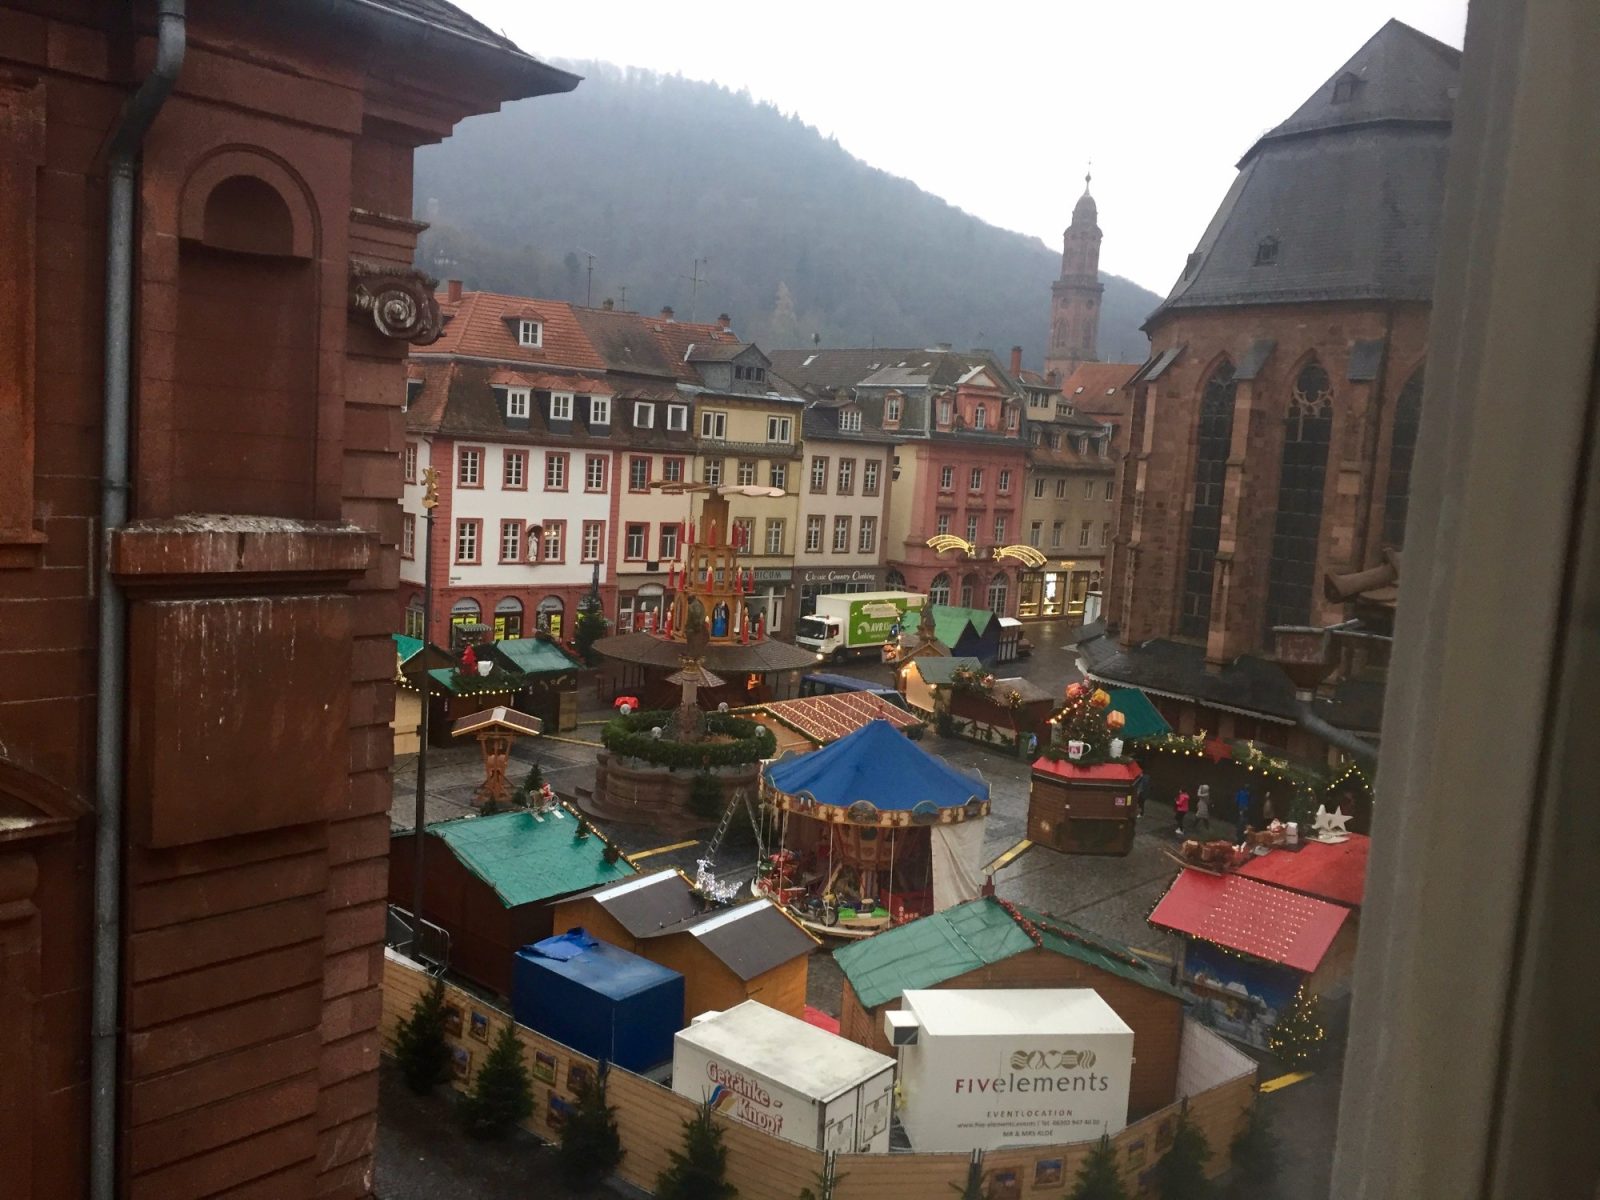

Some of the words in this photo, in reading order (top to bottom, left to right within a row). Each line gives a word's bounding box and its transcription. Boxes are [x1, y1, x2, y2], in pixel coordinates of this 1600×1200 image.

[828, 570, 850, 581] Country
[852, 570, 875, 580] Clothing
[870, 622, 883, 632] AVR
[706, 1060, 770, 1107] Getränke
[736, 1097, 783, 1135] Knopf
[986, 1109, 1073, 1118] EVENTLOCATION
